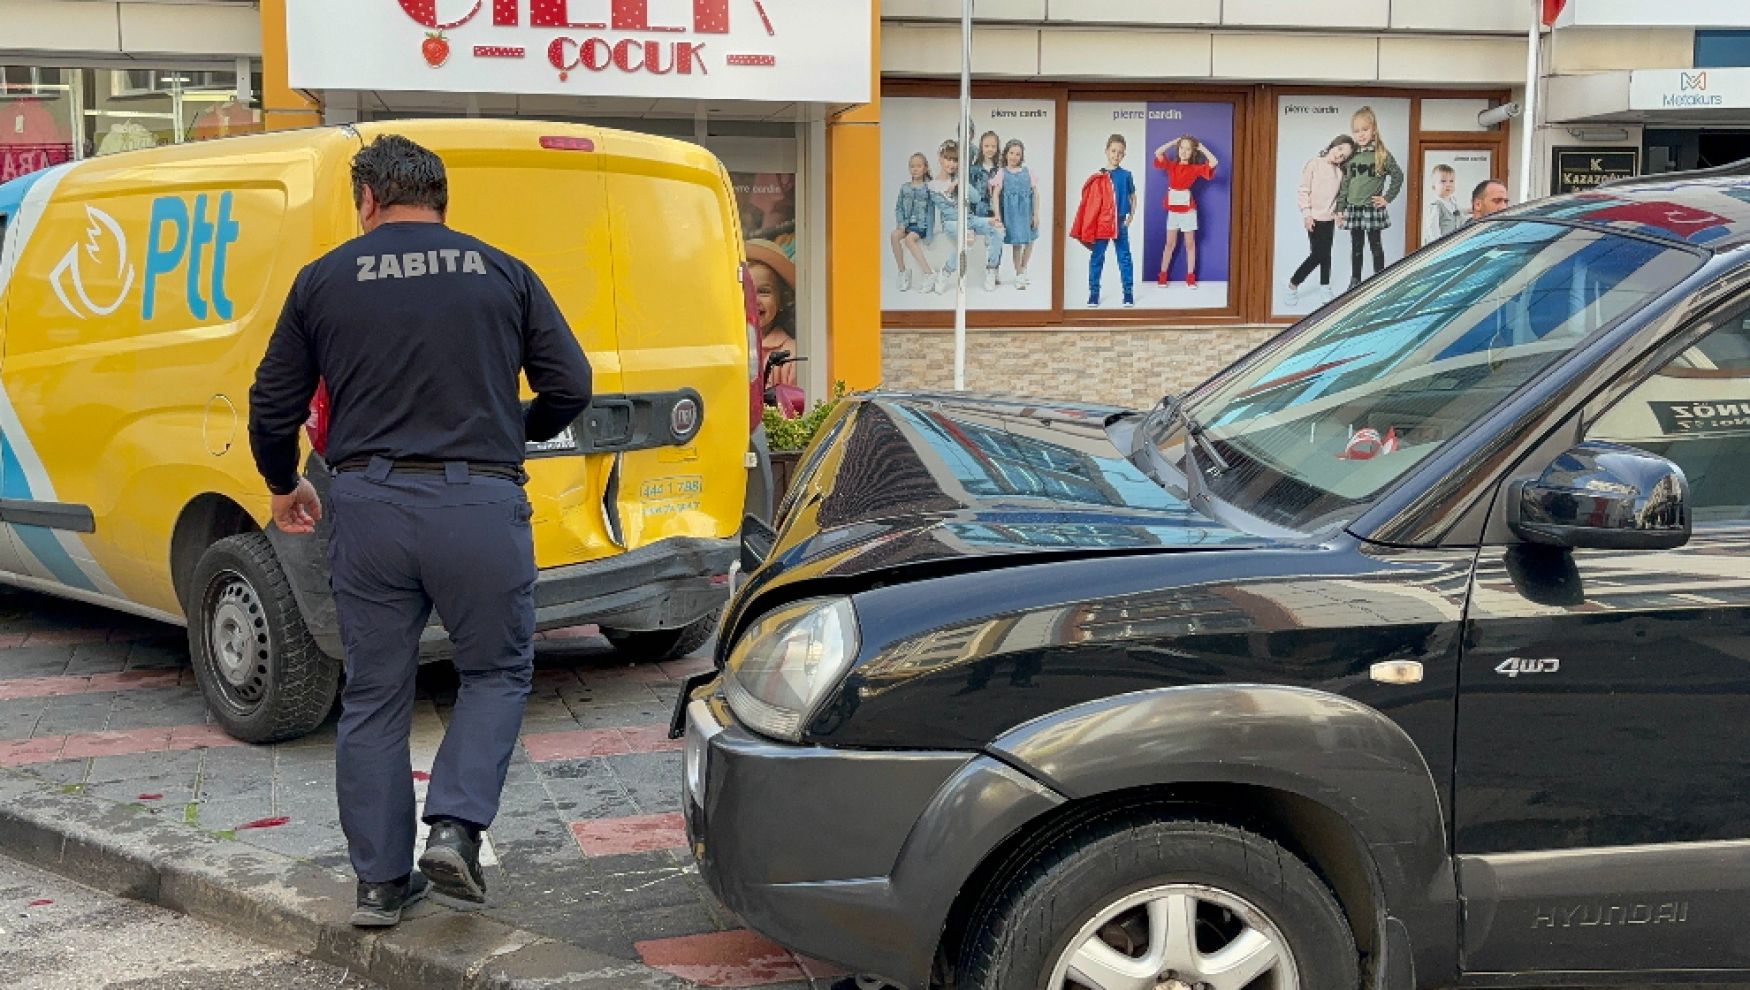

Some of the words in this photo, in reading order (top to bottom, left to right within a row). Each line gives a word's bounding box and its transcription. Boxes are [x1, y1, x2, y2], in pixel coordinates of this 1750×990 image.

[547, 36, 708, 82] ÇOCUK
[1284, 104, 1310, 115] pierre
[1311, 105, 1339, 114] cardin
[1663, 93, 1723, 107] Metakurs
[991, 109, 1017, 119] pierre
[1019, 108, 1047, 118] cardin
[1113, 109, 1145, 120] pierre
[1148, 108, 1182, 120] cardin
[141, 190, 239, 320] Ptt
[356, 248, 487, 281] ZABITA
[1494, 657, 1560, 678] 4WD
[1530, 901, 1690, 929] HYUNDAI
